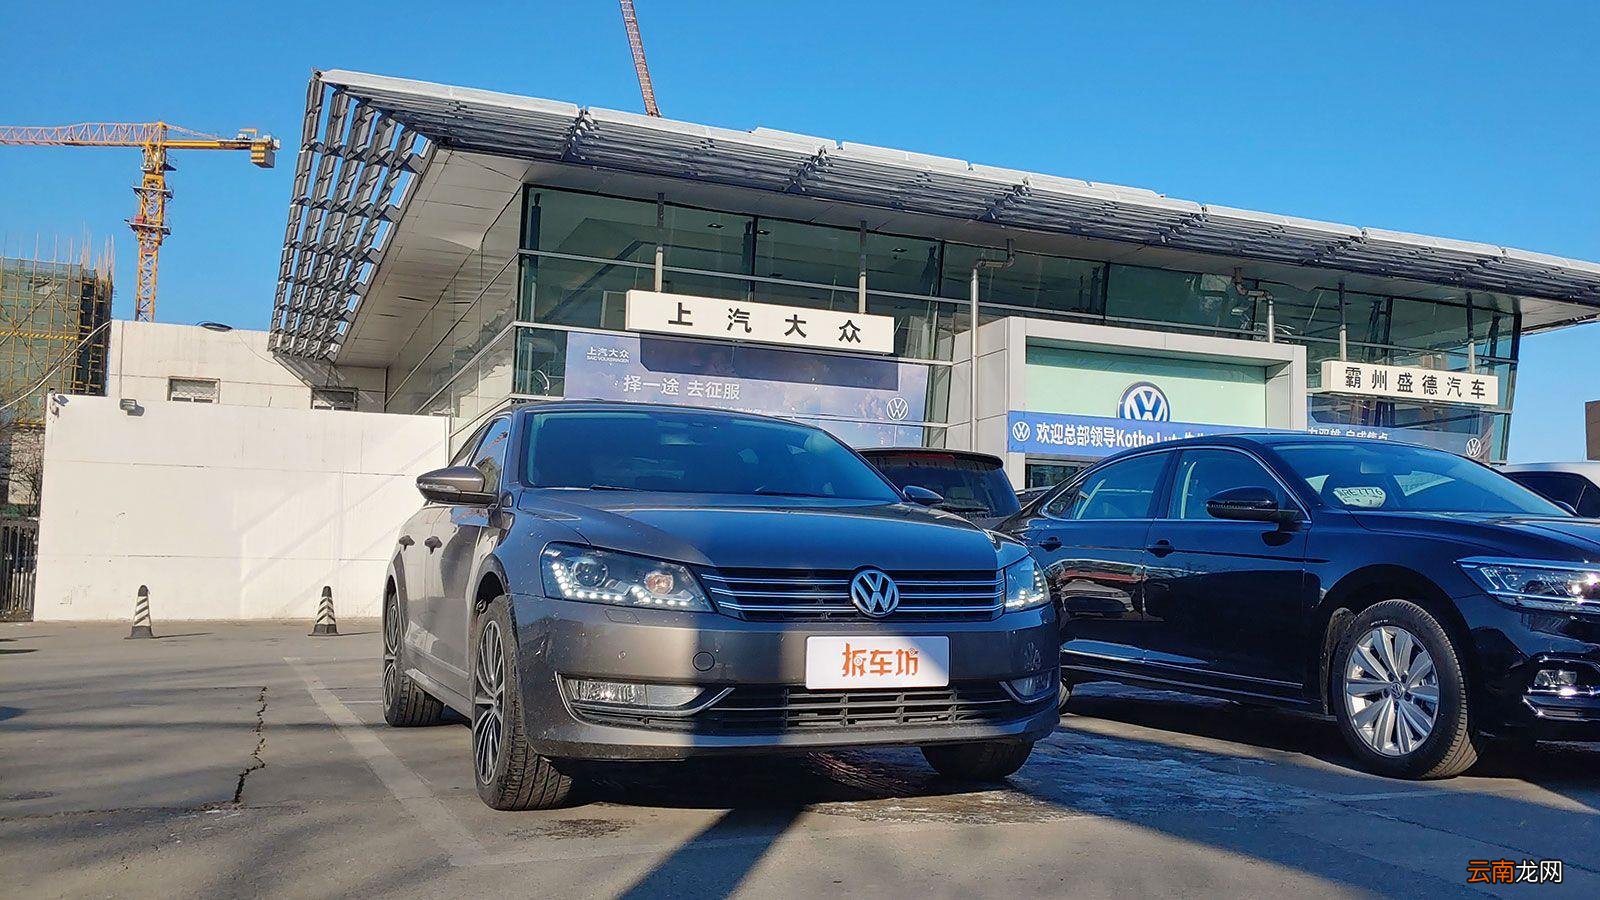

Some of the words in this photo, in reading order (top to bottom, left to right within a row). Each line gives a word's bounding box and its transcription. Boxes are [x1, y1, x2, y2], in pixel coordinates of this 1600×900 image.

[668, 302, 861, 344] 上汽大众
[586, 346, 629, 359] 上汽大众
[623, 374, 680, 396] 择一途
[687, 380, 740, 400] 去征服
[1345, 366, 1486, 400] 霸州盛德汽车
[841, 642, 919, 677] 拆车坊
